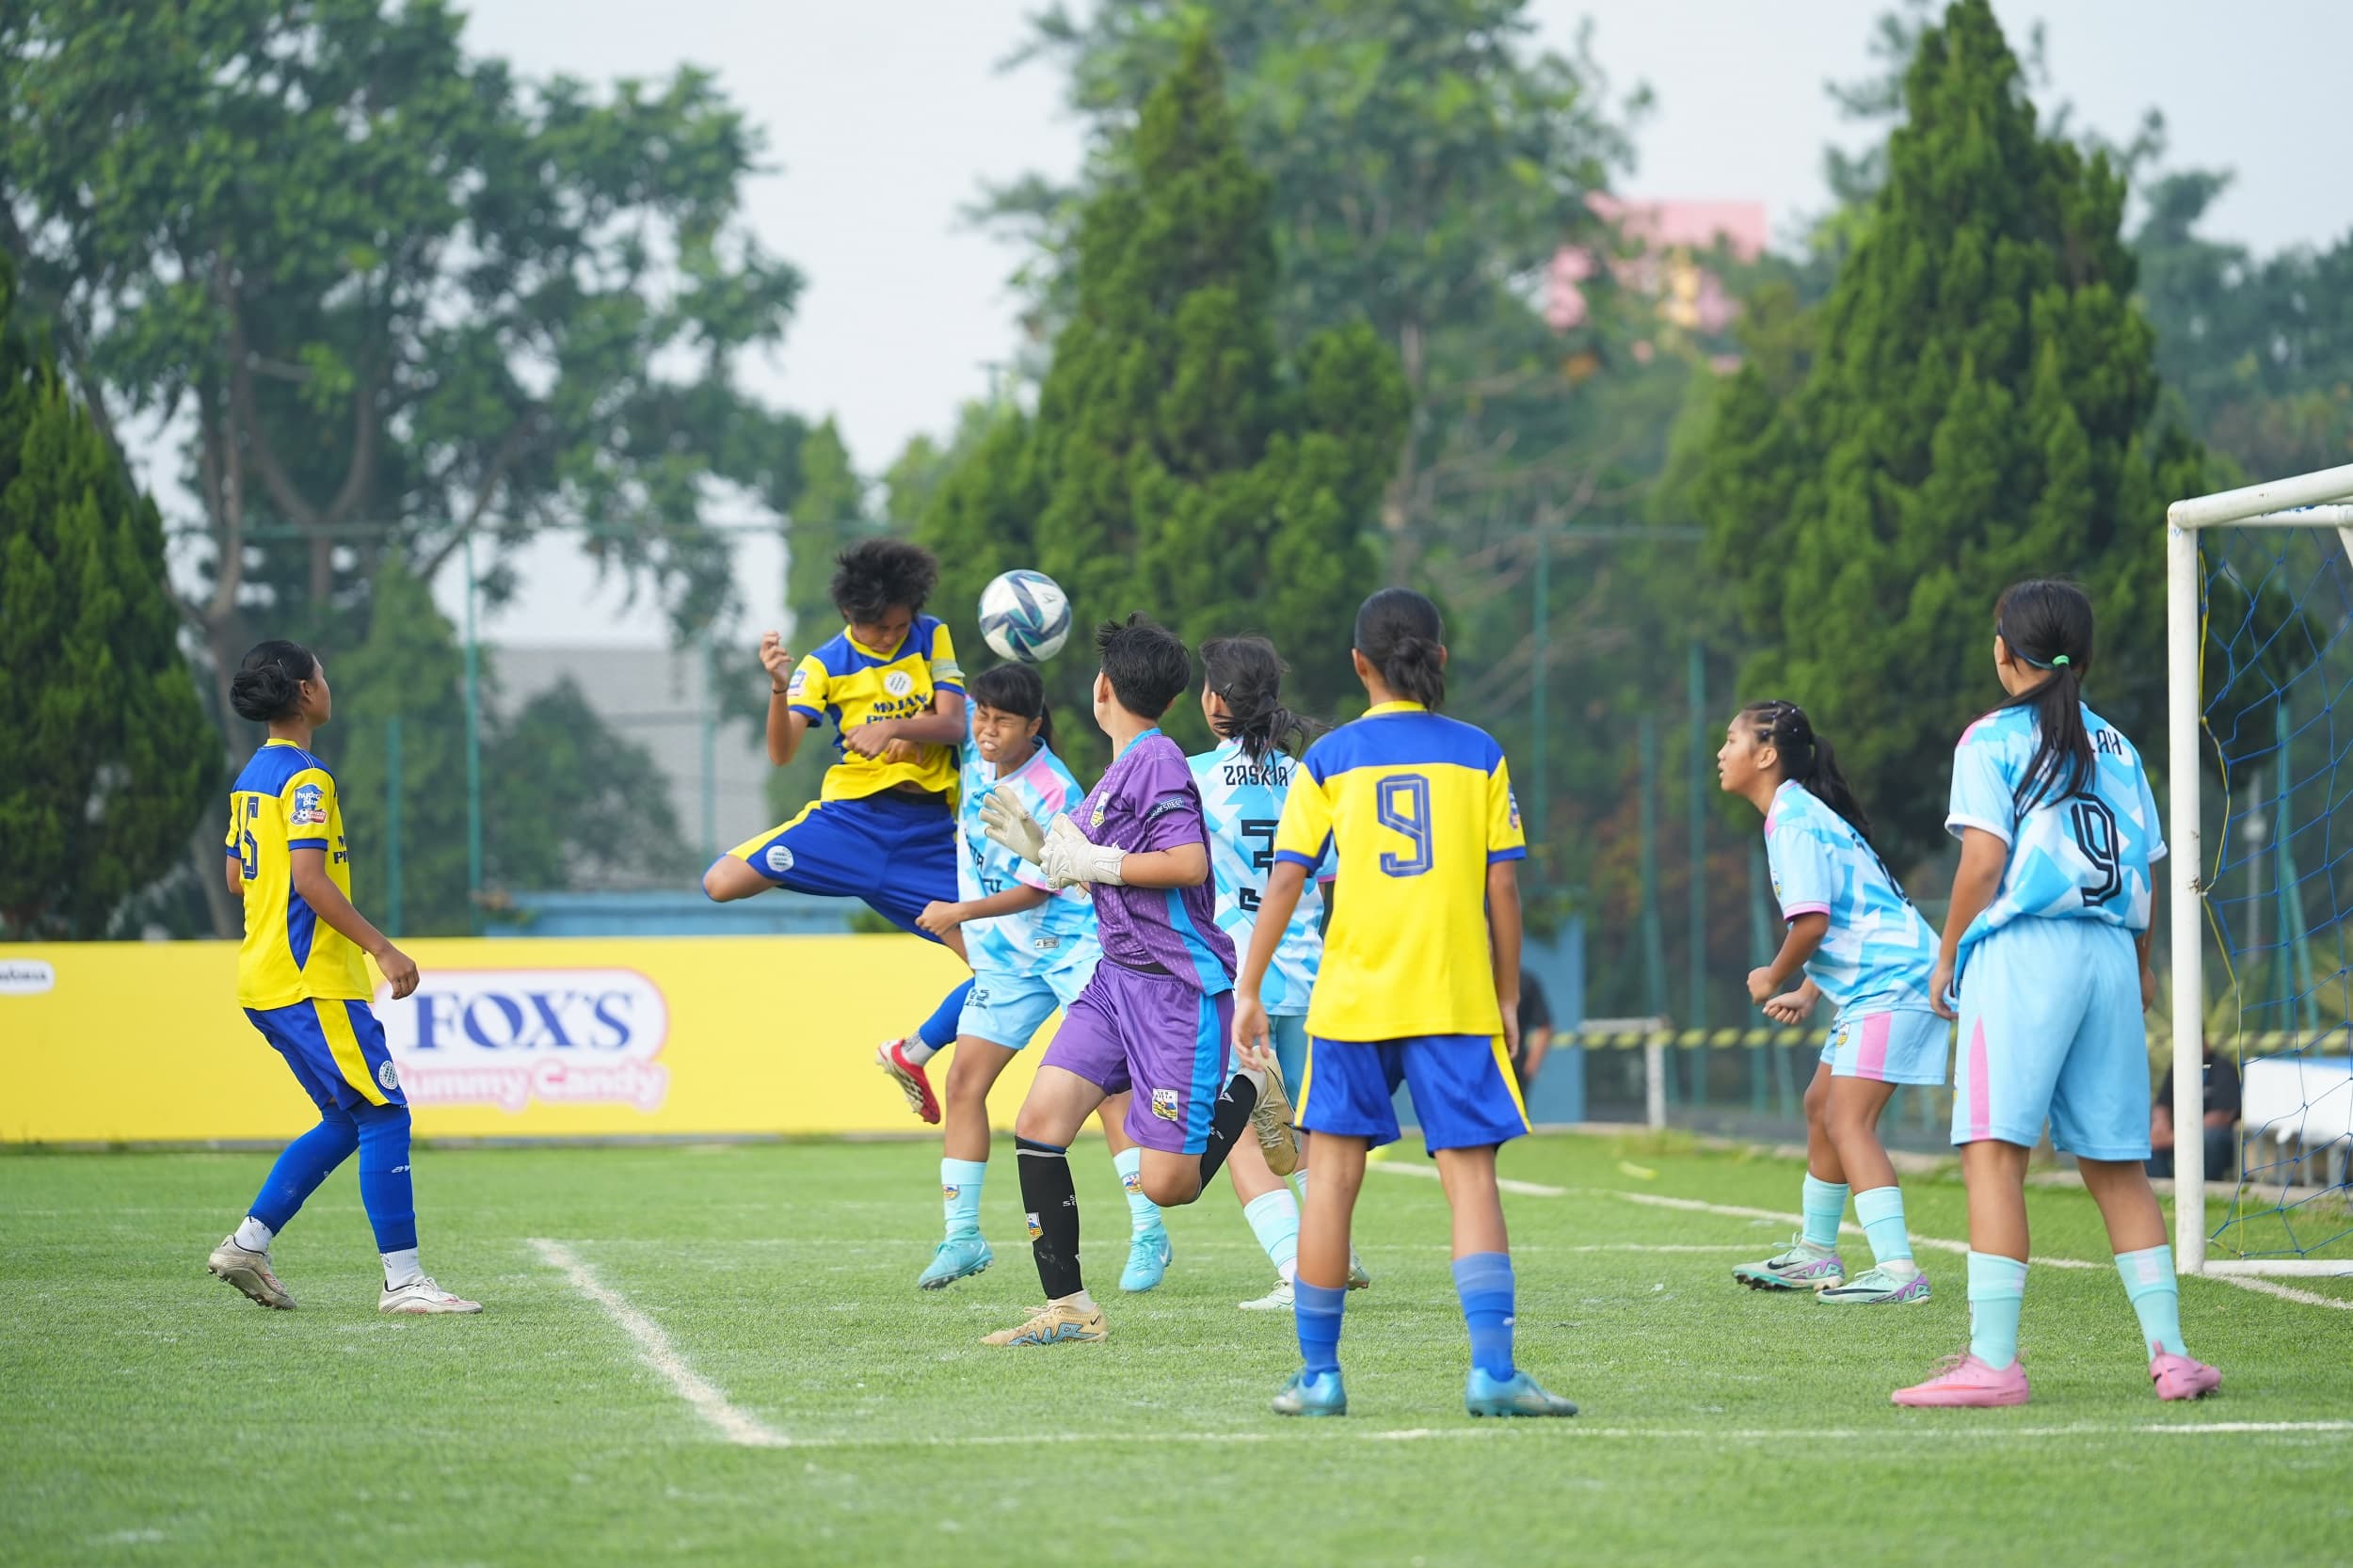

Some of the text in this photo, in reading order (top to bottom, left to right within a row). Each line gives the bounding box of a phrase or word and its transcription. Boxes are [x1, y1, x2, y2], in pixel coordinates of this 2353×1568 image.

[1224, 765, 1289, 787] ZASKIA
[1376, 774, 1433, 878] 9
[2071, 792, 2121, 906] 9
[408, 992, 634, 1050] FOX'S
[399, 1063, 528, 1110] ummy
